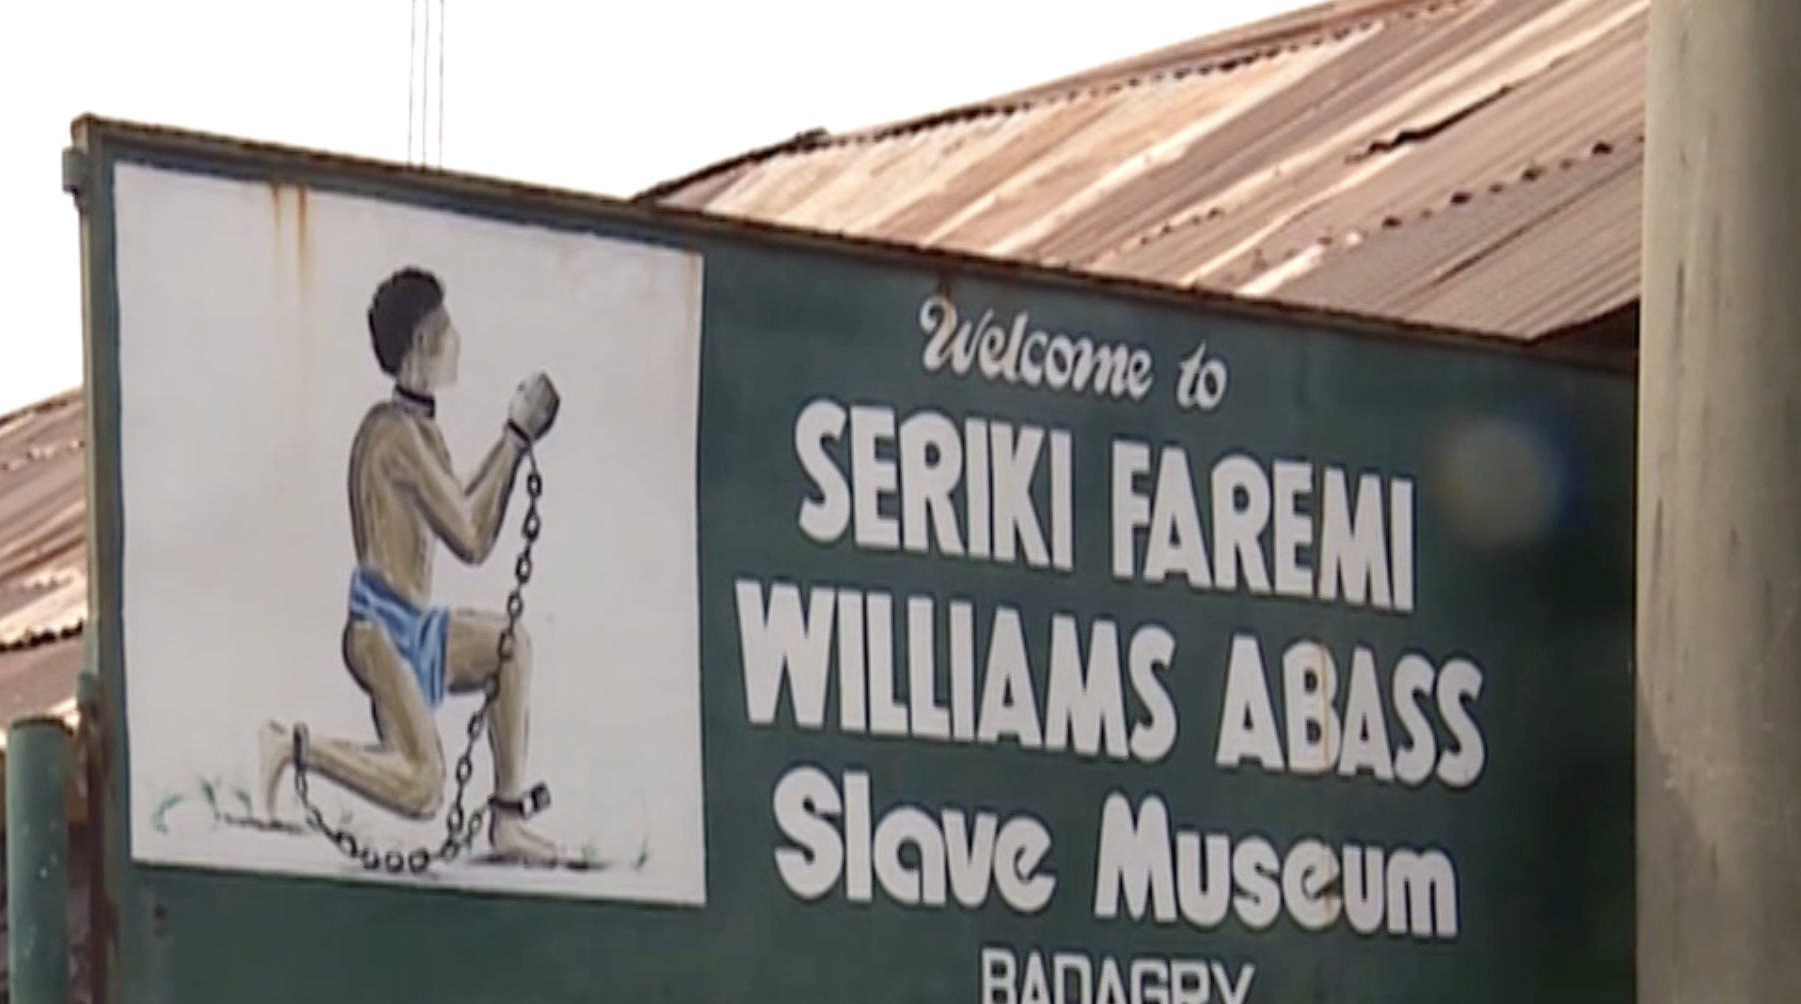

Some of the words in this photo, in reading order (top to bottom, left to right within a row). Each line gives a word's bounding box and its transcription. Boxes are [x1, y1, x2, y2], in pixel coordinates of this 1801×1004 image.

[920, 298, 1152, 398] Welcome
[1177, 346, 1227, 408] to
[795, 400, 1072, 570] SERIKI
[1112, 440, 1413, 610] FAREMI
[735, 579, 1176, 760] WILLIAMS
[1216, 636, 1484, 784] ABASS
[773, 767, 1055, 911] Slave
[1095, 794, 1456, 934] Museum
